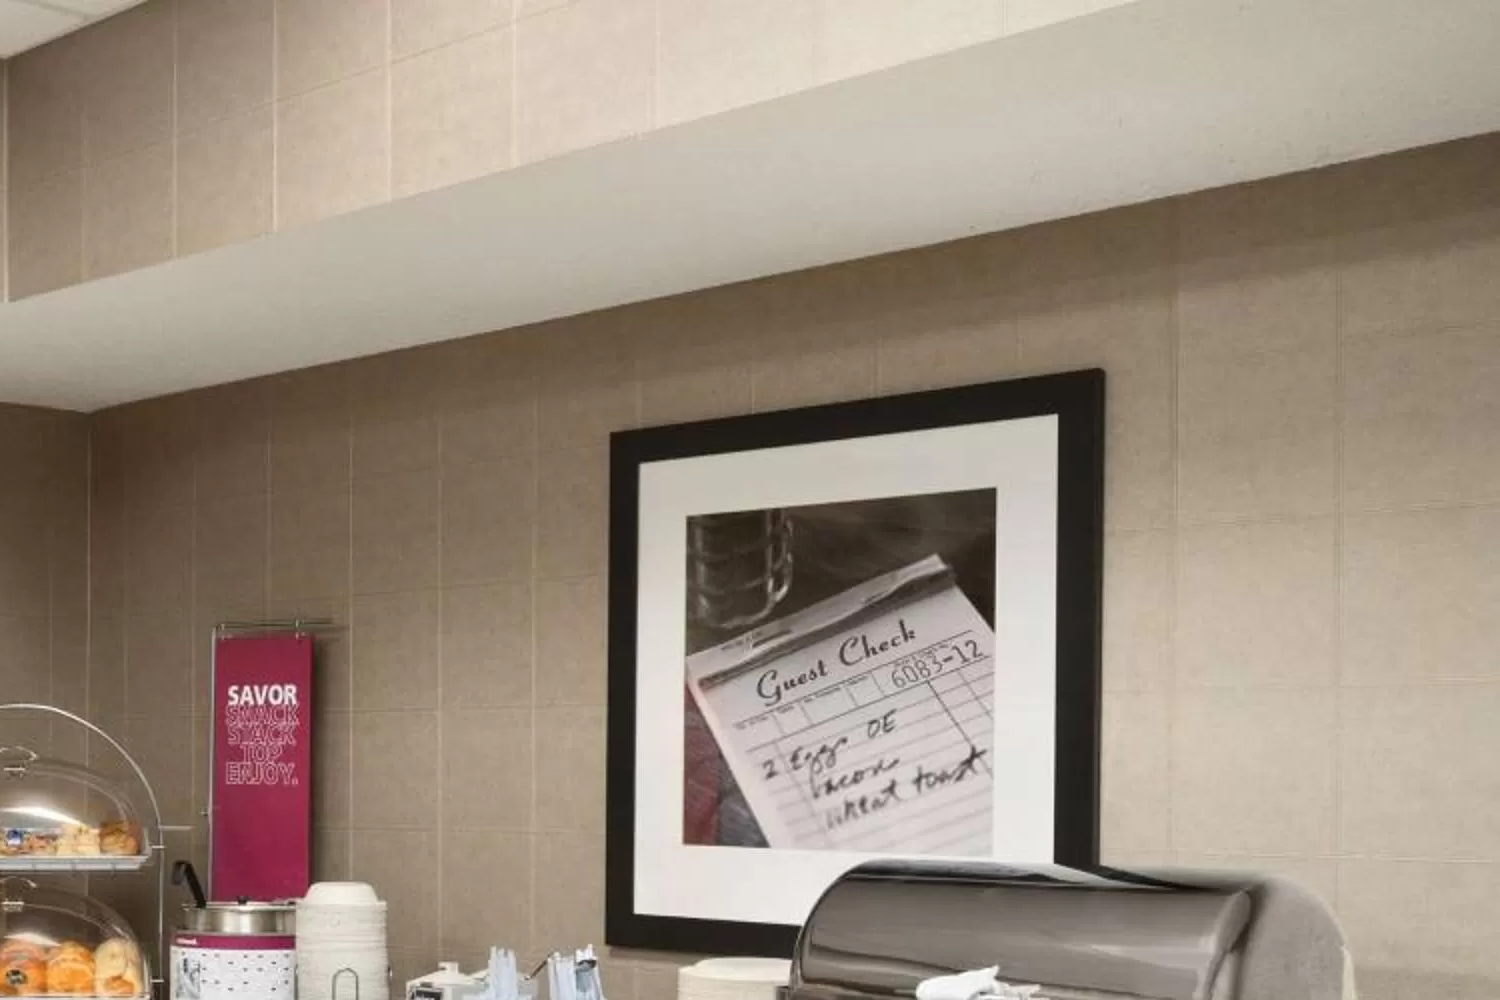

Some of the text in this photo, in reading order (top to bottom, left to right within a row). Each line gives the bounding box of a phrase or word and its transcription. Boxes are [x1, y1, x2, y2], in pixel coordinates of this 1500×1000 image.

[756, 660, 828, 707] Guest
[837, 618, 917, 666] Check
[891, 638, 984, 689] 6083-12
[227, 684, 298, 706] SAVOR
[227, 722, 296, 745] STACK
[240, 743, 283, 764] TOP
[225, 761, 299, 785] ENJOY.
[761, 758, 779, 781] 2
